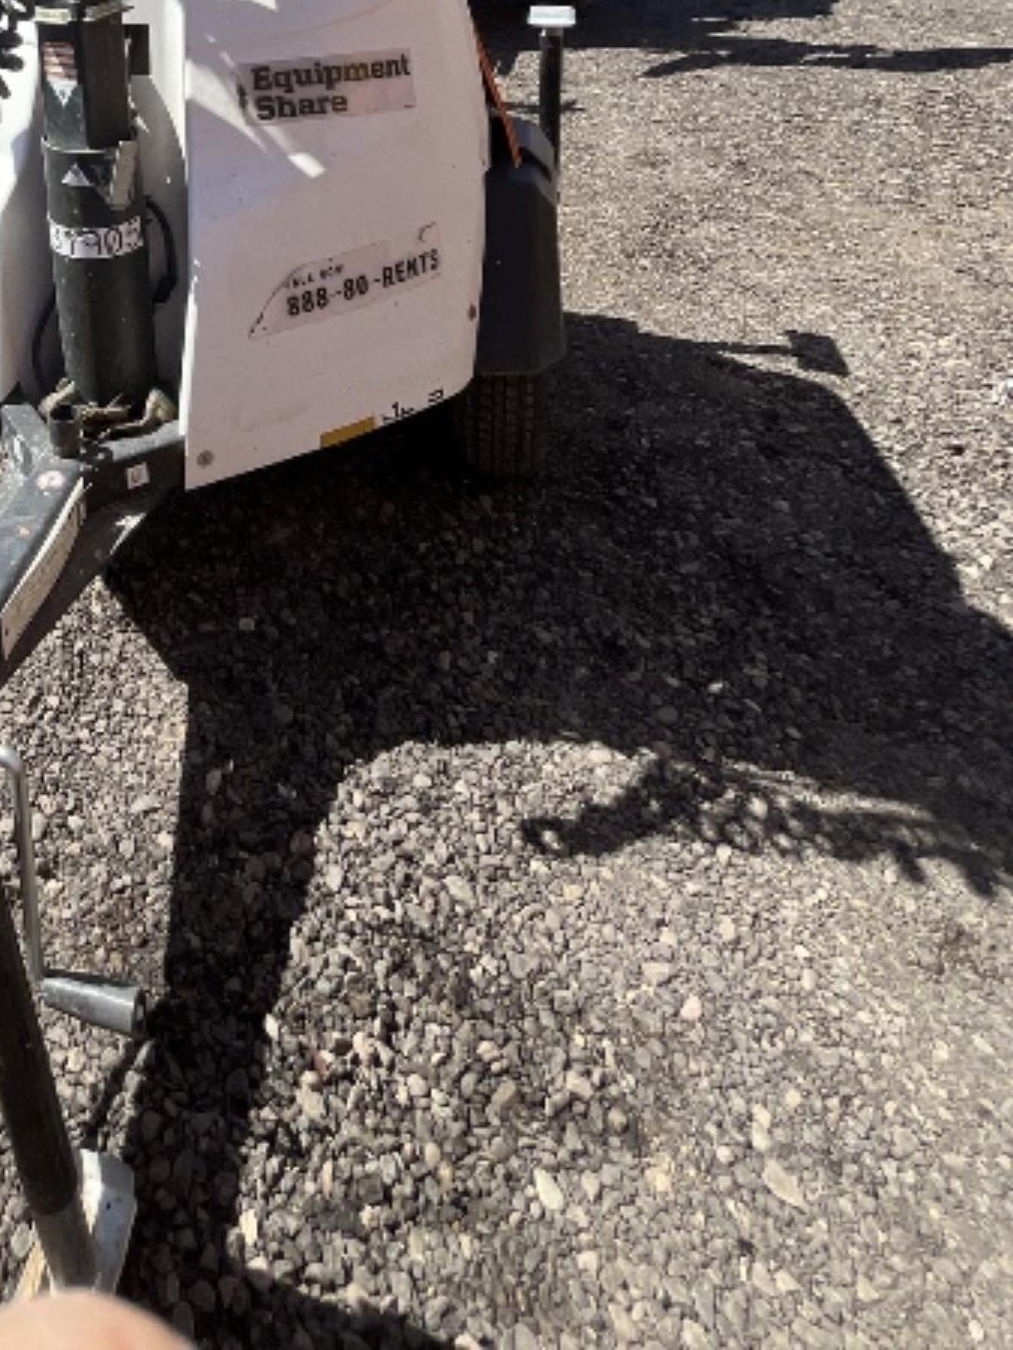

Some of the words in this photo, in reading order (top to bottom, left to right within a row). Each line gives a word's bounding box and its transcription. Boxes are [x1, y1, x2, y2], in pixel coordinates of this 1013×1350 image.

[251, 53, 411, 93] Equipment
[254, 95, 349, 120] Share
[287, 248, 439, 317] 888-80-RENTS
